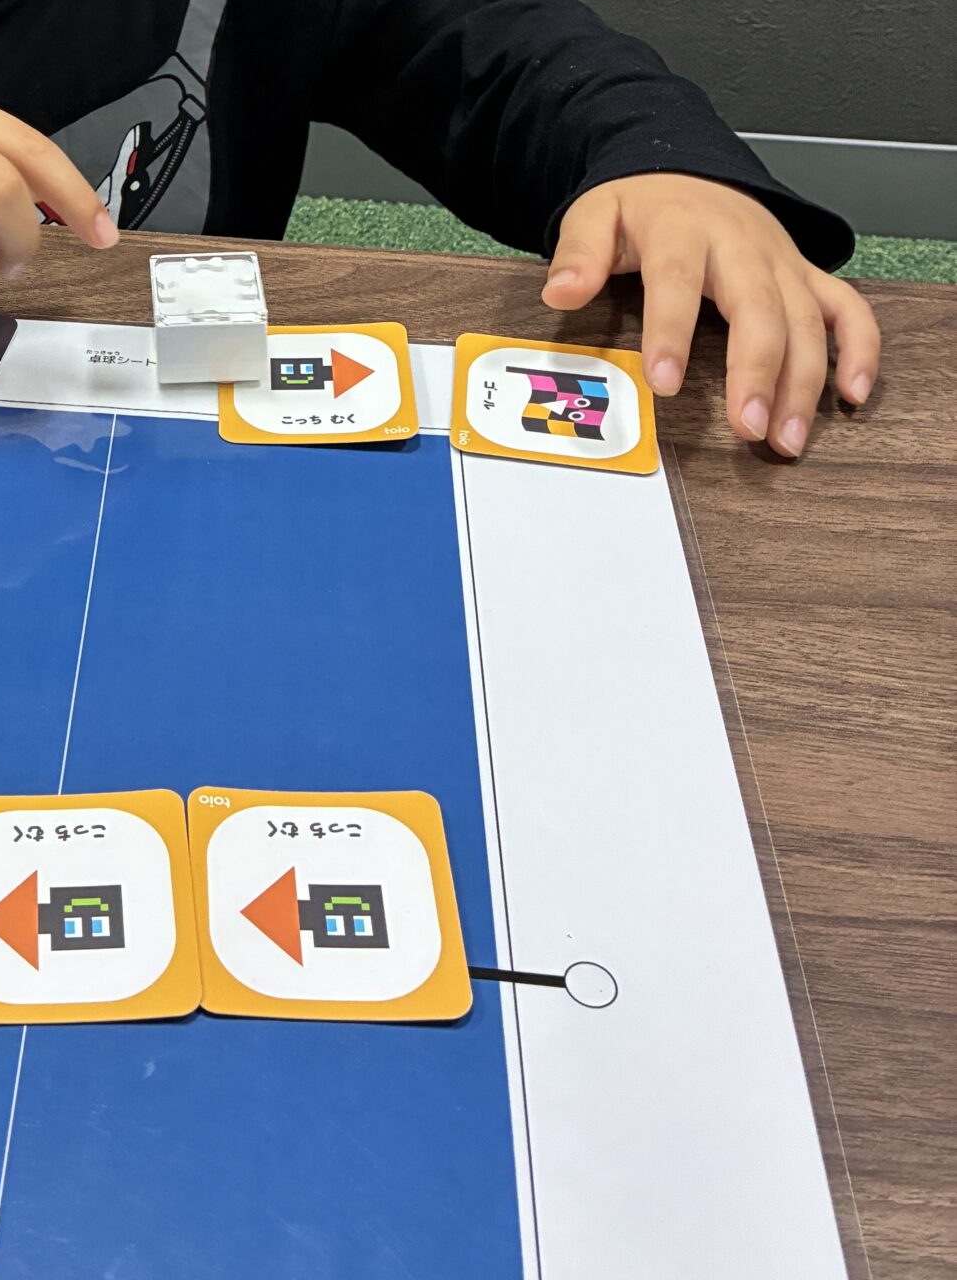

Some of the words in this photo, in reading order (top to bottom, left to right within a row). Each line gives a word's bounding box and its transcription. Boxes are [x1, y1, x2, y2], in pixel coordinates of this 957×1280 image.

[88, 354, 158, 366] 卓球シート
[483, 380, 498, 410] ゴール
[282, 415, 322, 425] こっち
[331, 414, 355, 424] むく
[384, 426, 411, 435] toio
[459, 430, 471, 446] toio
[198, 794, 230, 809] toio
[13, 825, 45, 842] むく
[54, 824, 106, 842] こっち
[267, 820, 299, 839] むく
[309, 822, 362, 839] こっち
